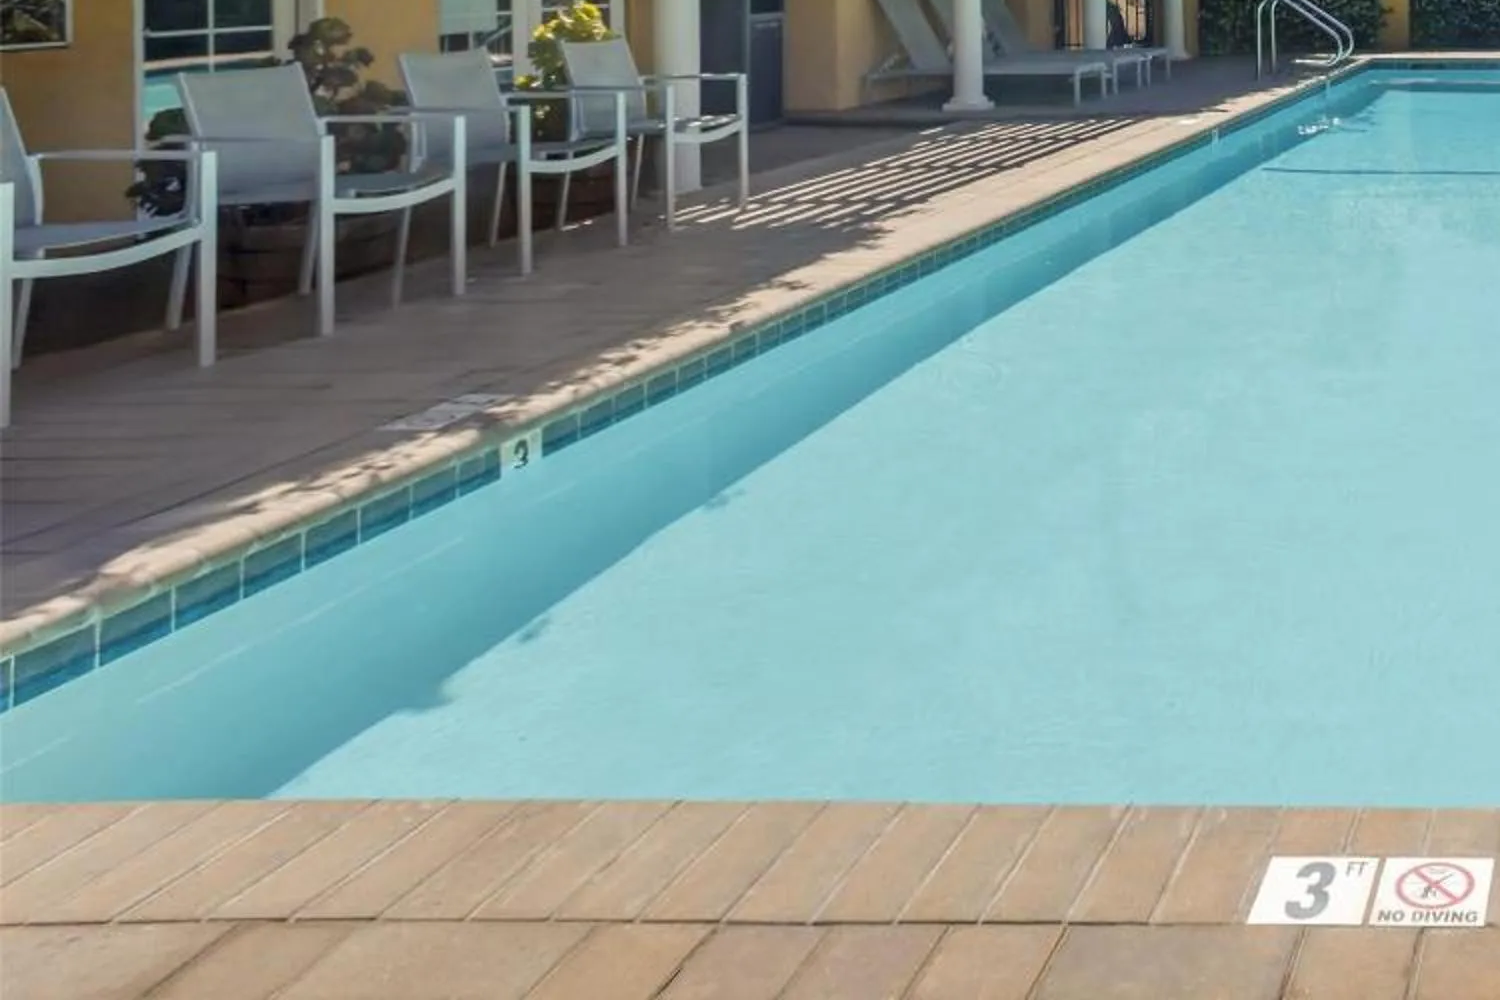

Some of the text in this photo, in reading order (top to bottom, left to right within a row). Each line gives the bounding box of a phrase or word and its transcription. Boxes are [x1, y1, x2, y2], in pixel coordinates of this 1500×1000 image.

[1284, 861, 1368, 919] 3 FT
[1377, 910, 1478, 923] NO DIVING
